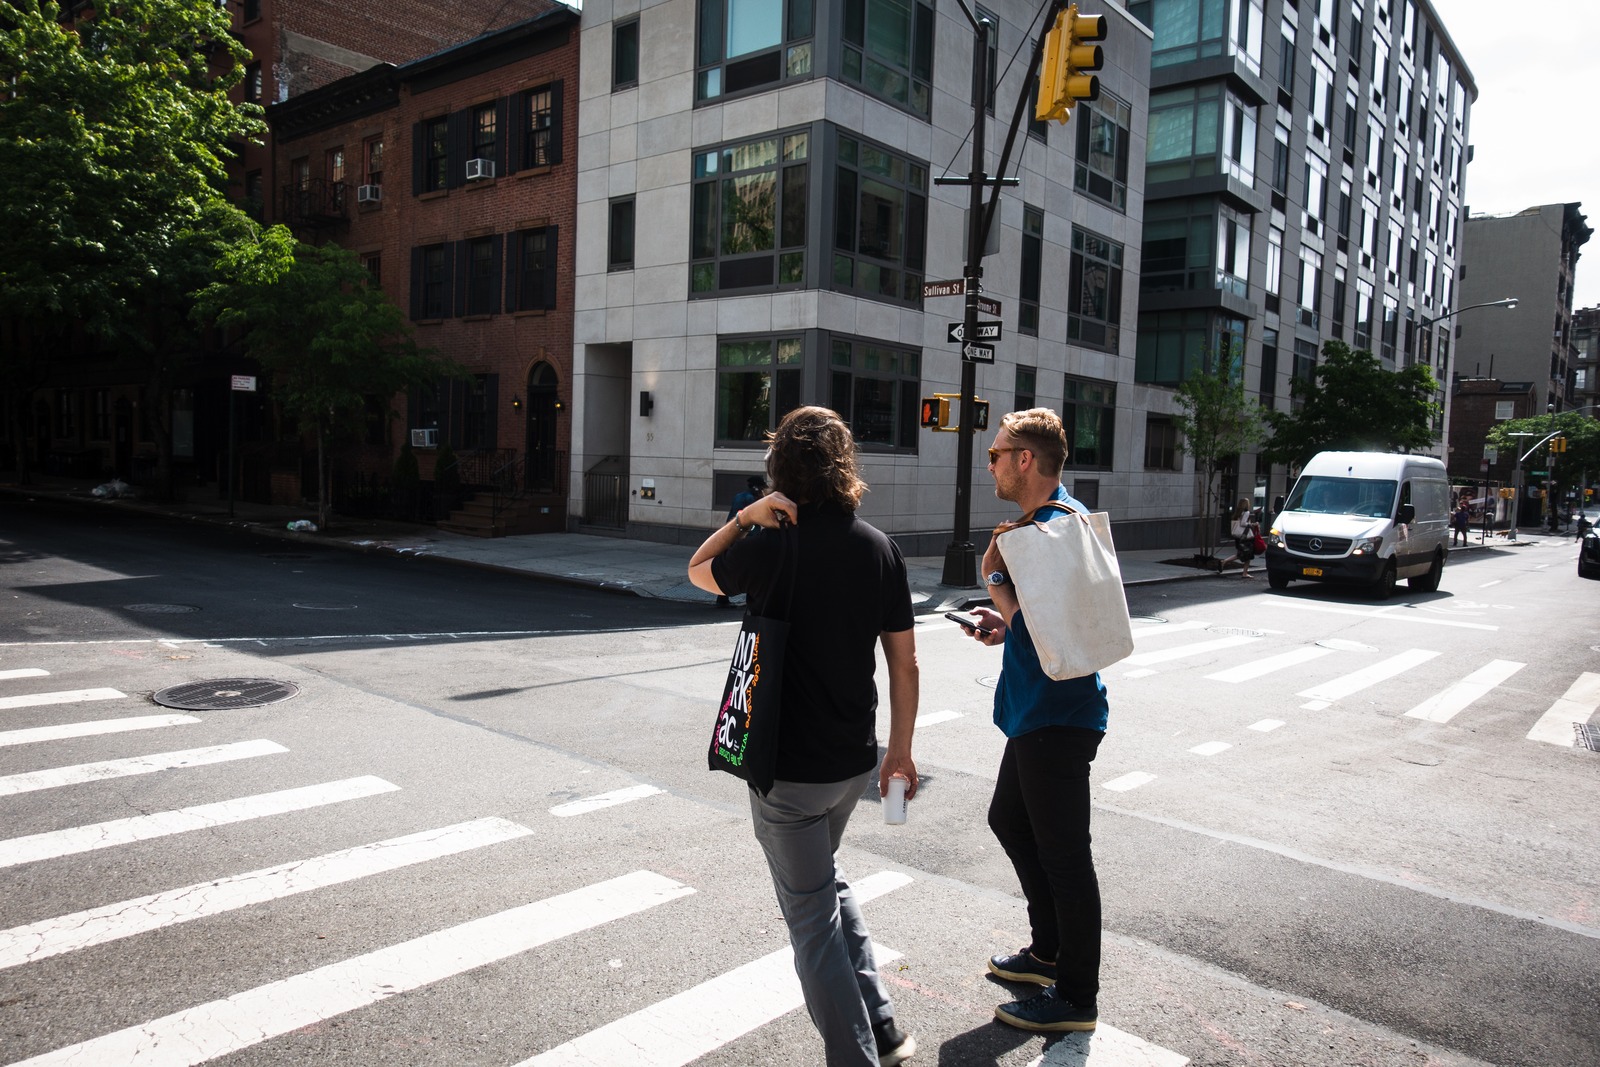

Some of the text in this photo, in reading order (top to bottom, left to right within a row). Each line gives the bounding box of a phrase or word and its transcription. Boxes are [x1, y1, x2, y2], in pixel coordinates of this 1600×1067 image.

[924, 283, 960, 296] Sullivan St
[977, 327, 995, 336] WAY
[967, 346, 991, 358] ONE WAY
